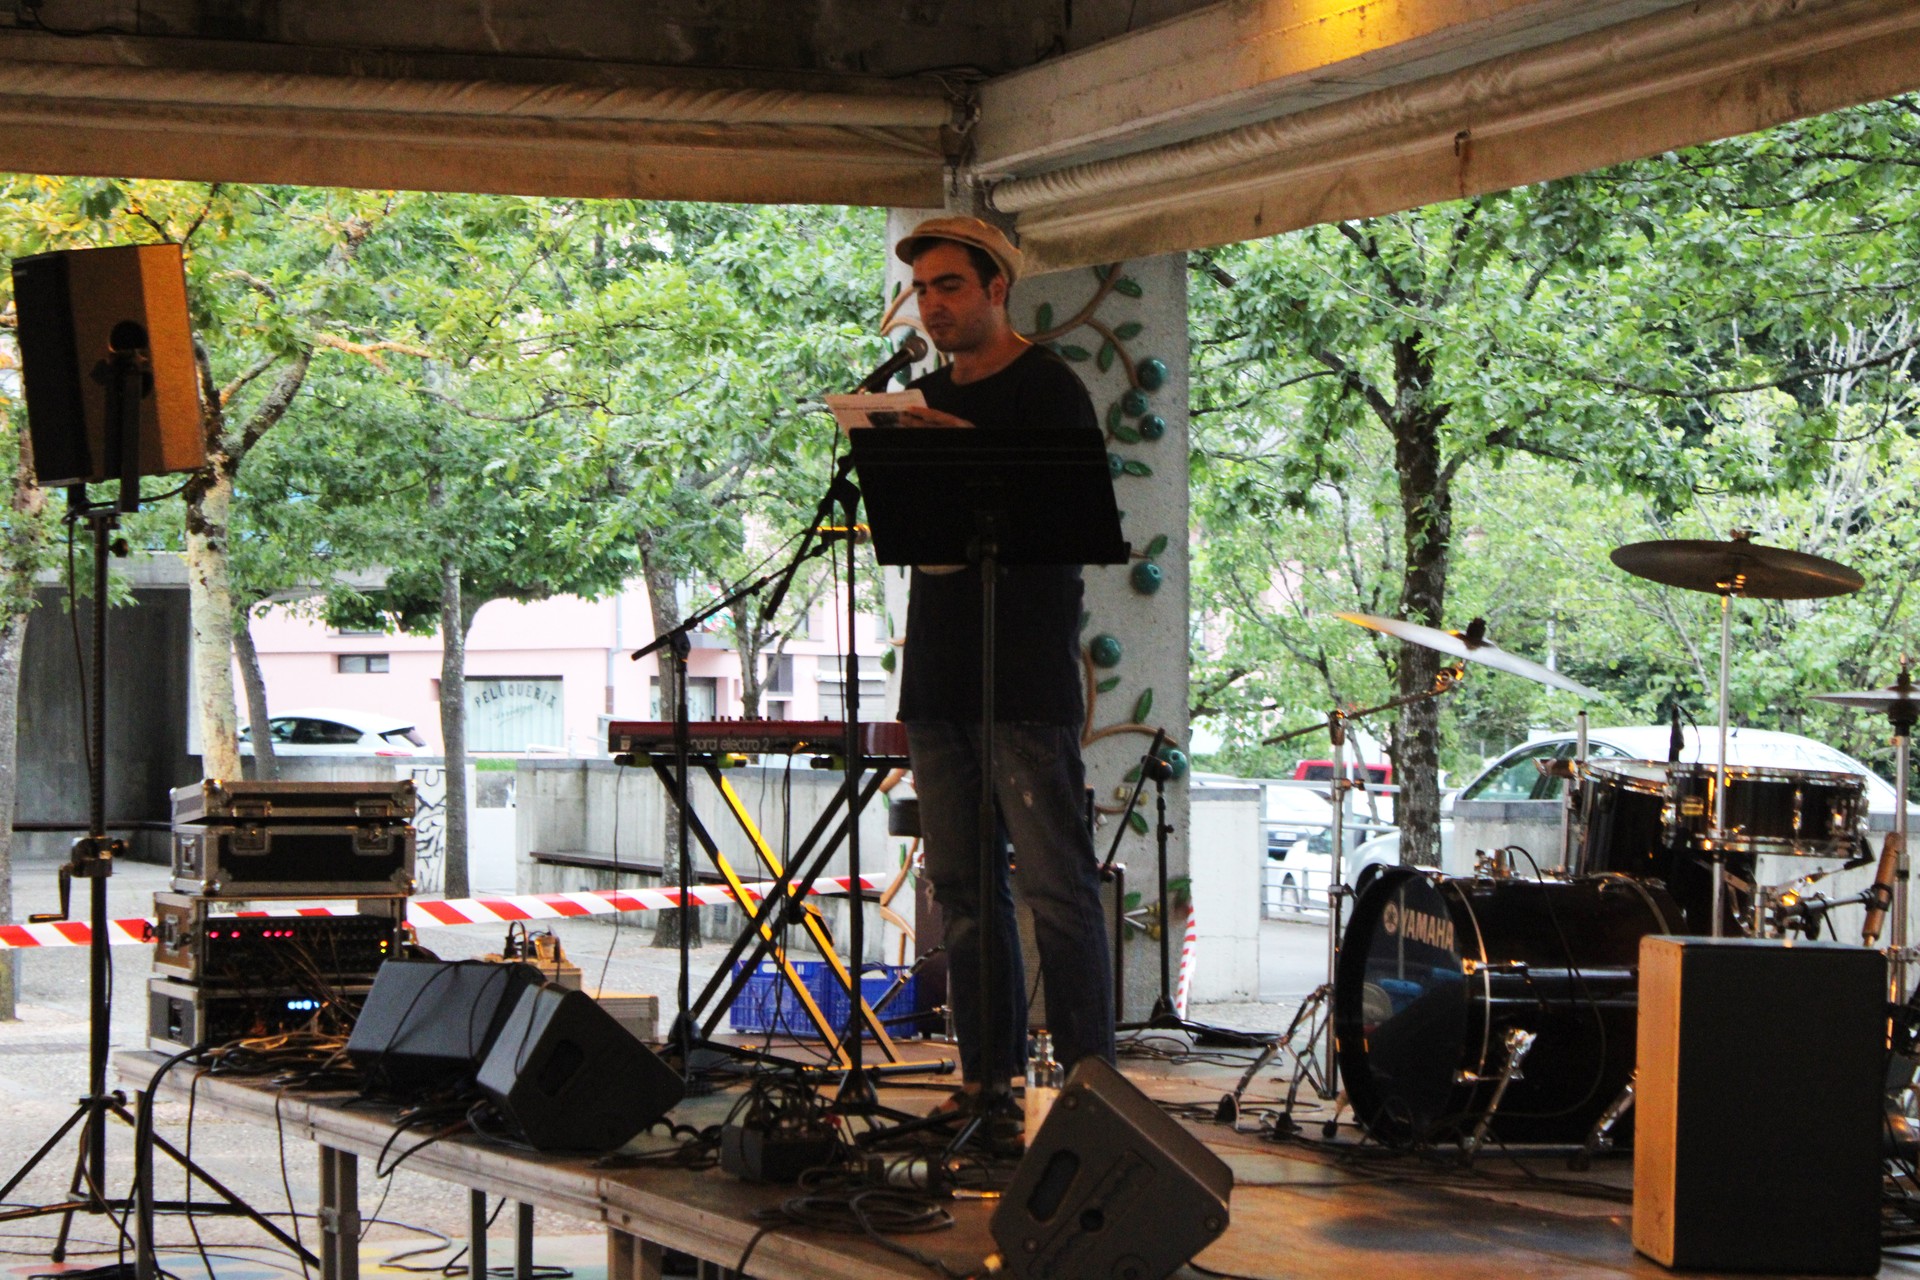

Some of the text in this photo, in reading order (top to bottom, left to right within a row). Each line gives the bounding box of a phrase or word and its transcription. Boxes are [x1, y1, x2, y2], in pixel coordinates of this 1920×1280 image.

[720, 738, 760, 751] electro
[762, 738, 770, 751] 2
[1401, 907, 1454, 952] YAMAHA
